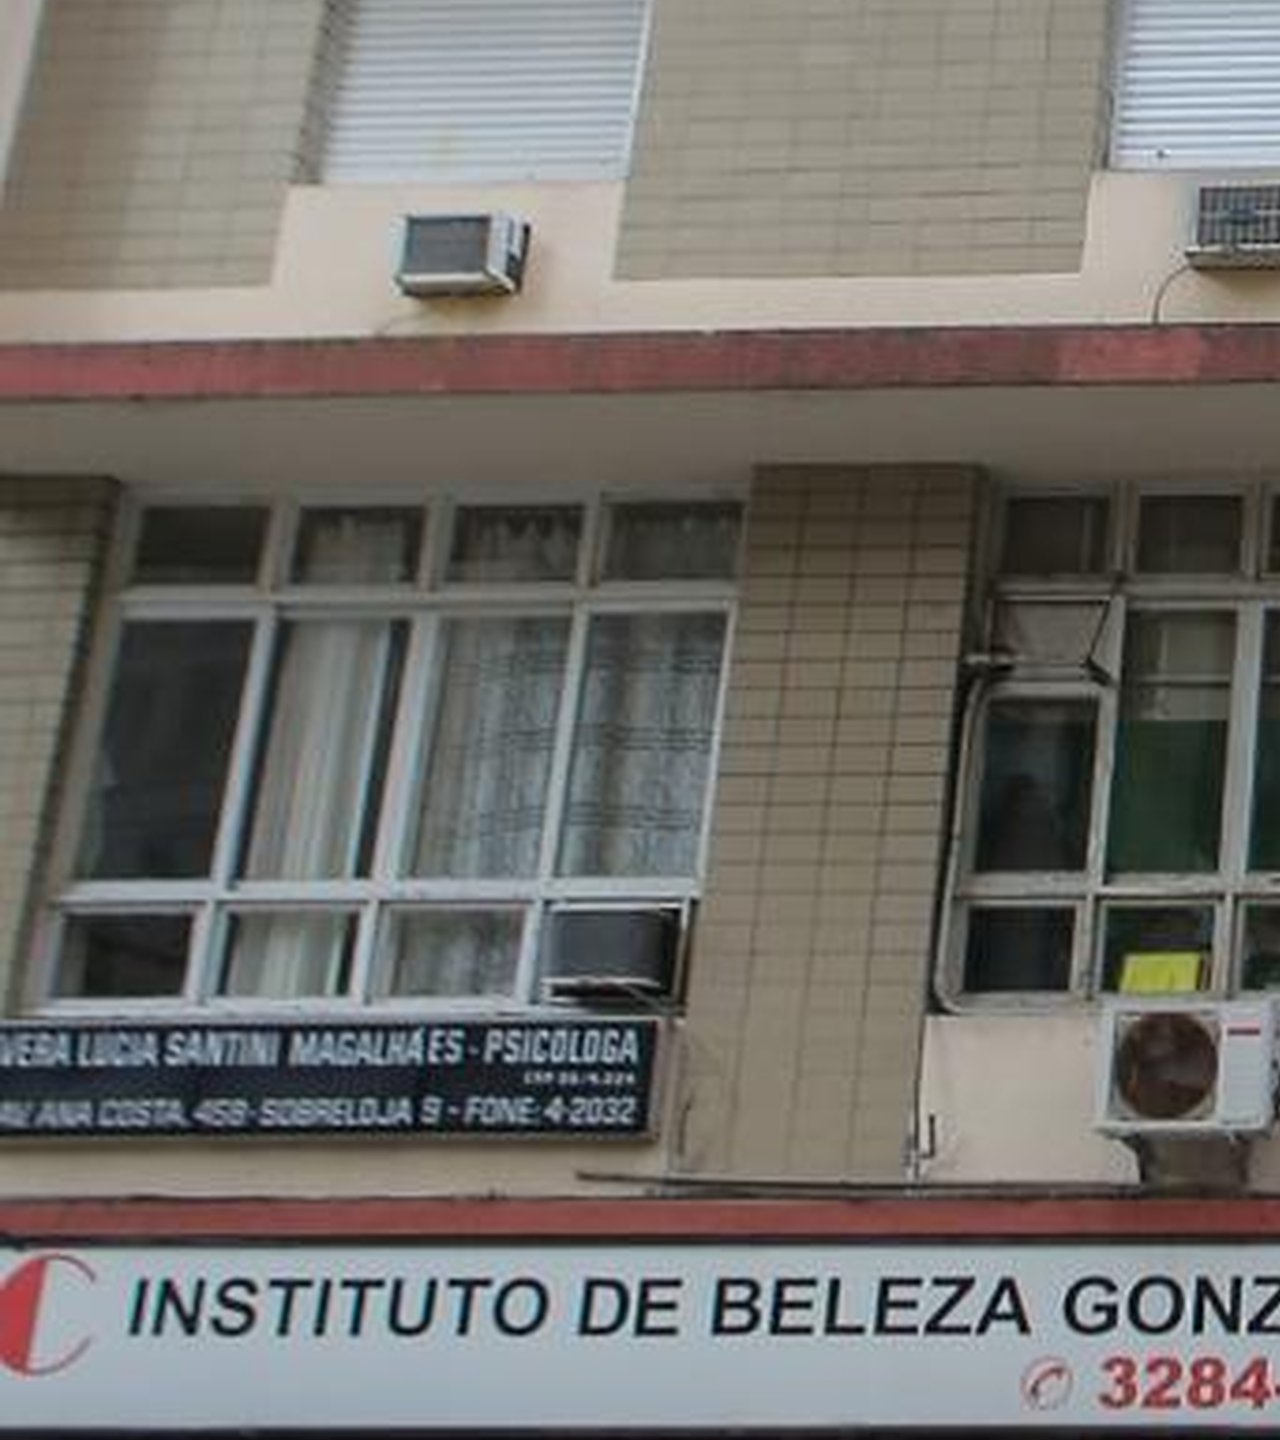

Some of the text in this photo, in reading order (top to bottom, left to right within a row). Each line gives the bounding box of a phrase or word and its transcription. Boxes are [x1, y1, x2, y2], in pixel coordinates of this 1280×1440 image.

[483, 1029, 640, 1064] PSICOLOGA
[128, 1276, 550, 1338] INSTITUTO
[578, 1277, 684, 1337] DE
[710, 1276, 1032, 1337] BELEZA
